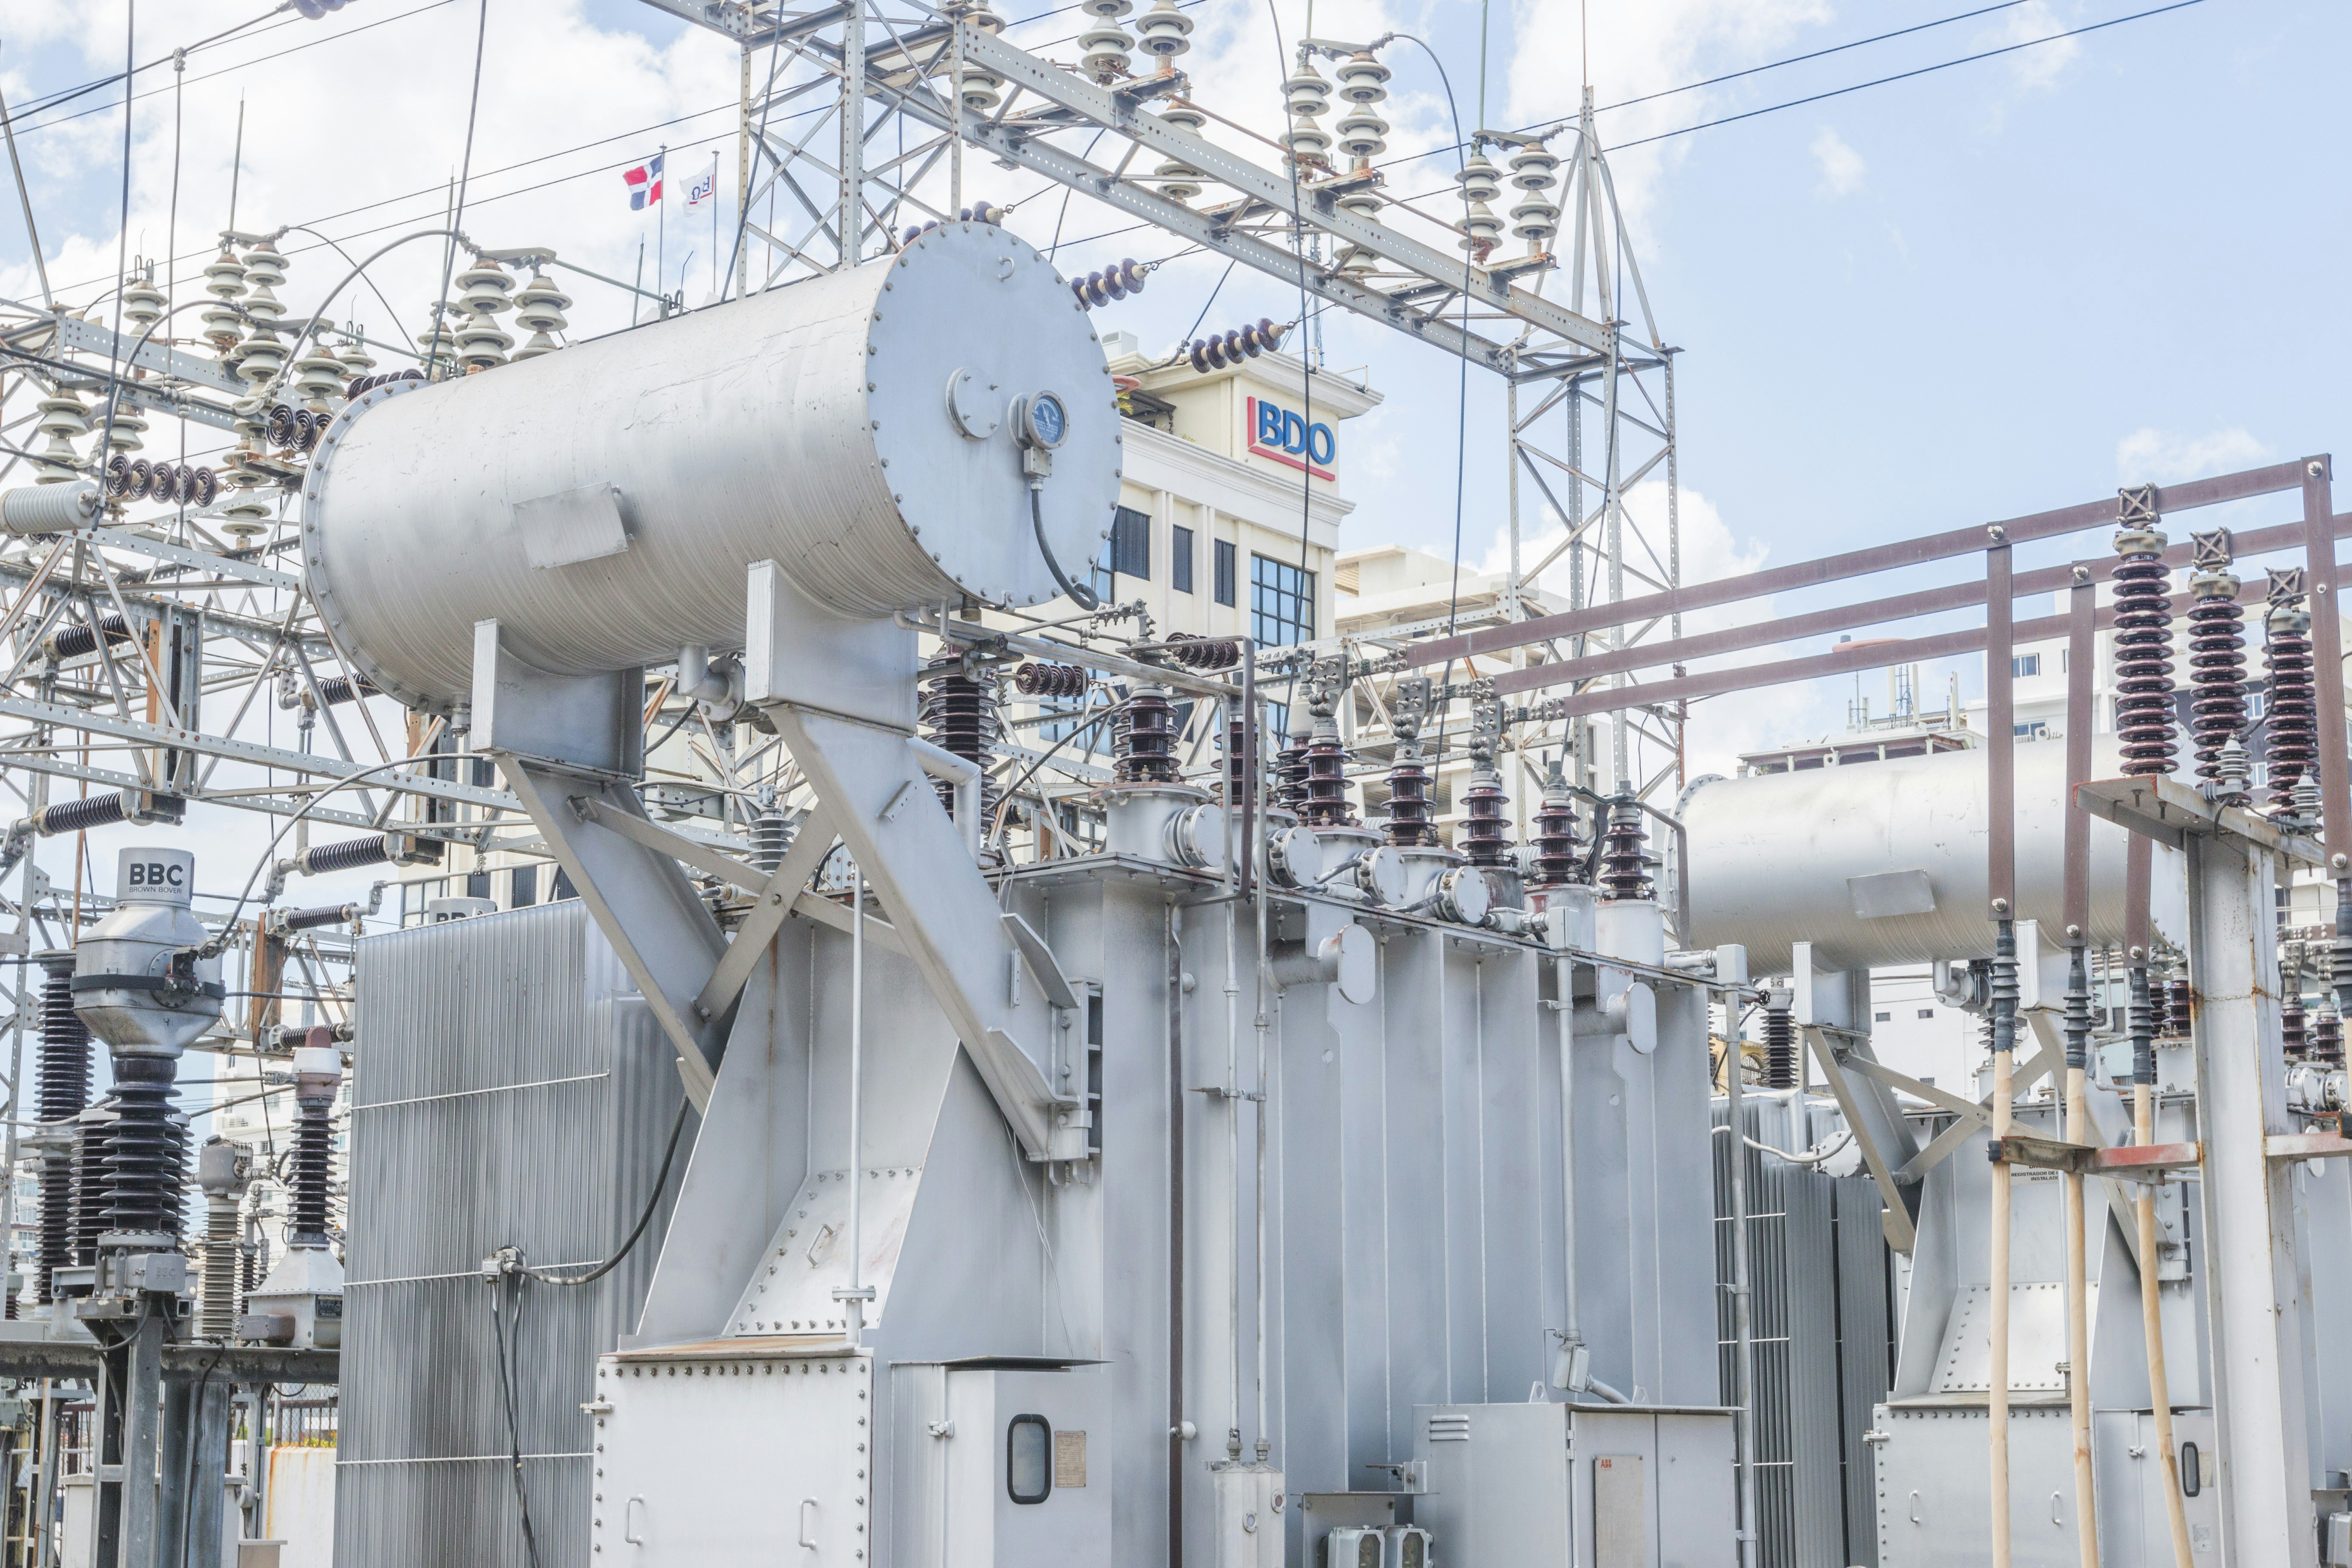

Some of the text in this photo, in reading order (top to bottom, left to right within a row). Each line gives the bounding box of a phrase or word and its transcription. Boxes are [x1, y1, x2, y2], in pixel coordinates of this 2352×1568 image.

[1258, 400, 1335, 465] BDO
[130, 863, 183, 886] BBC
[1601, 1459, 1611, 1468] ABB
